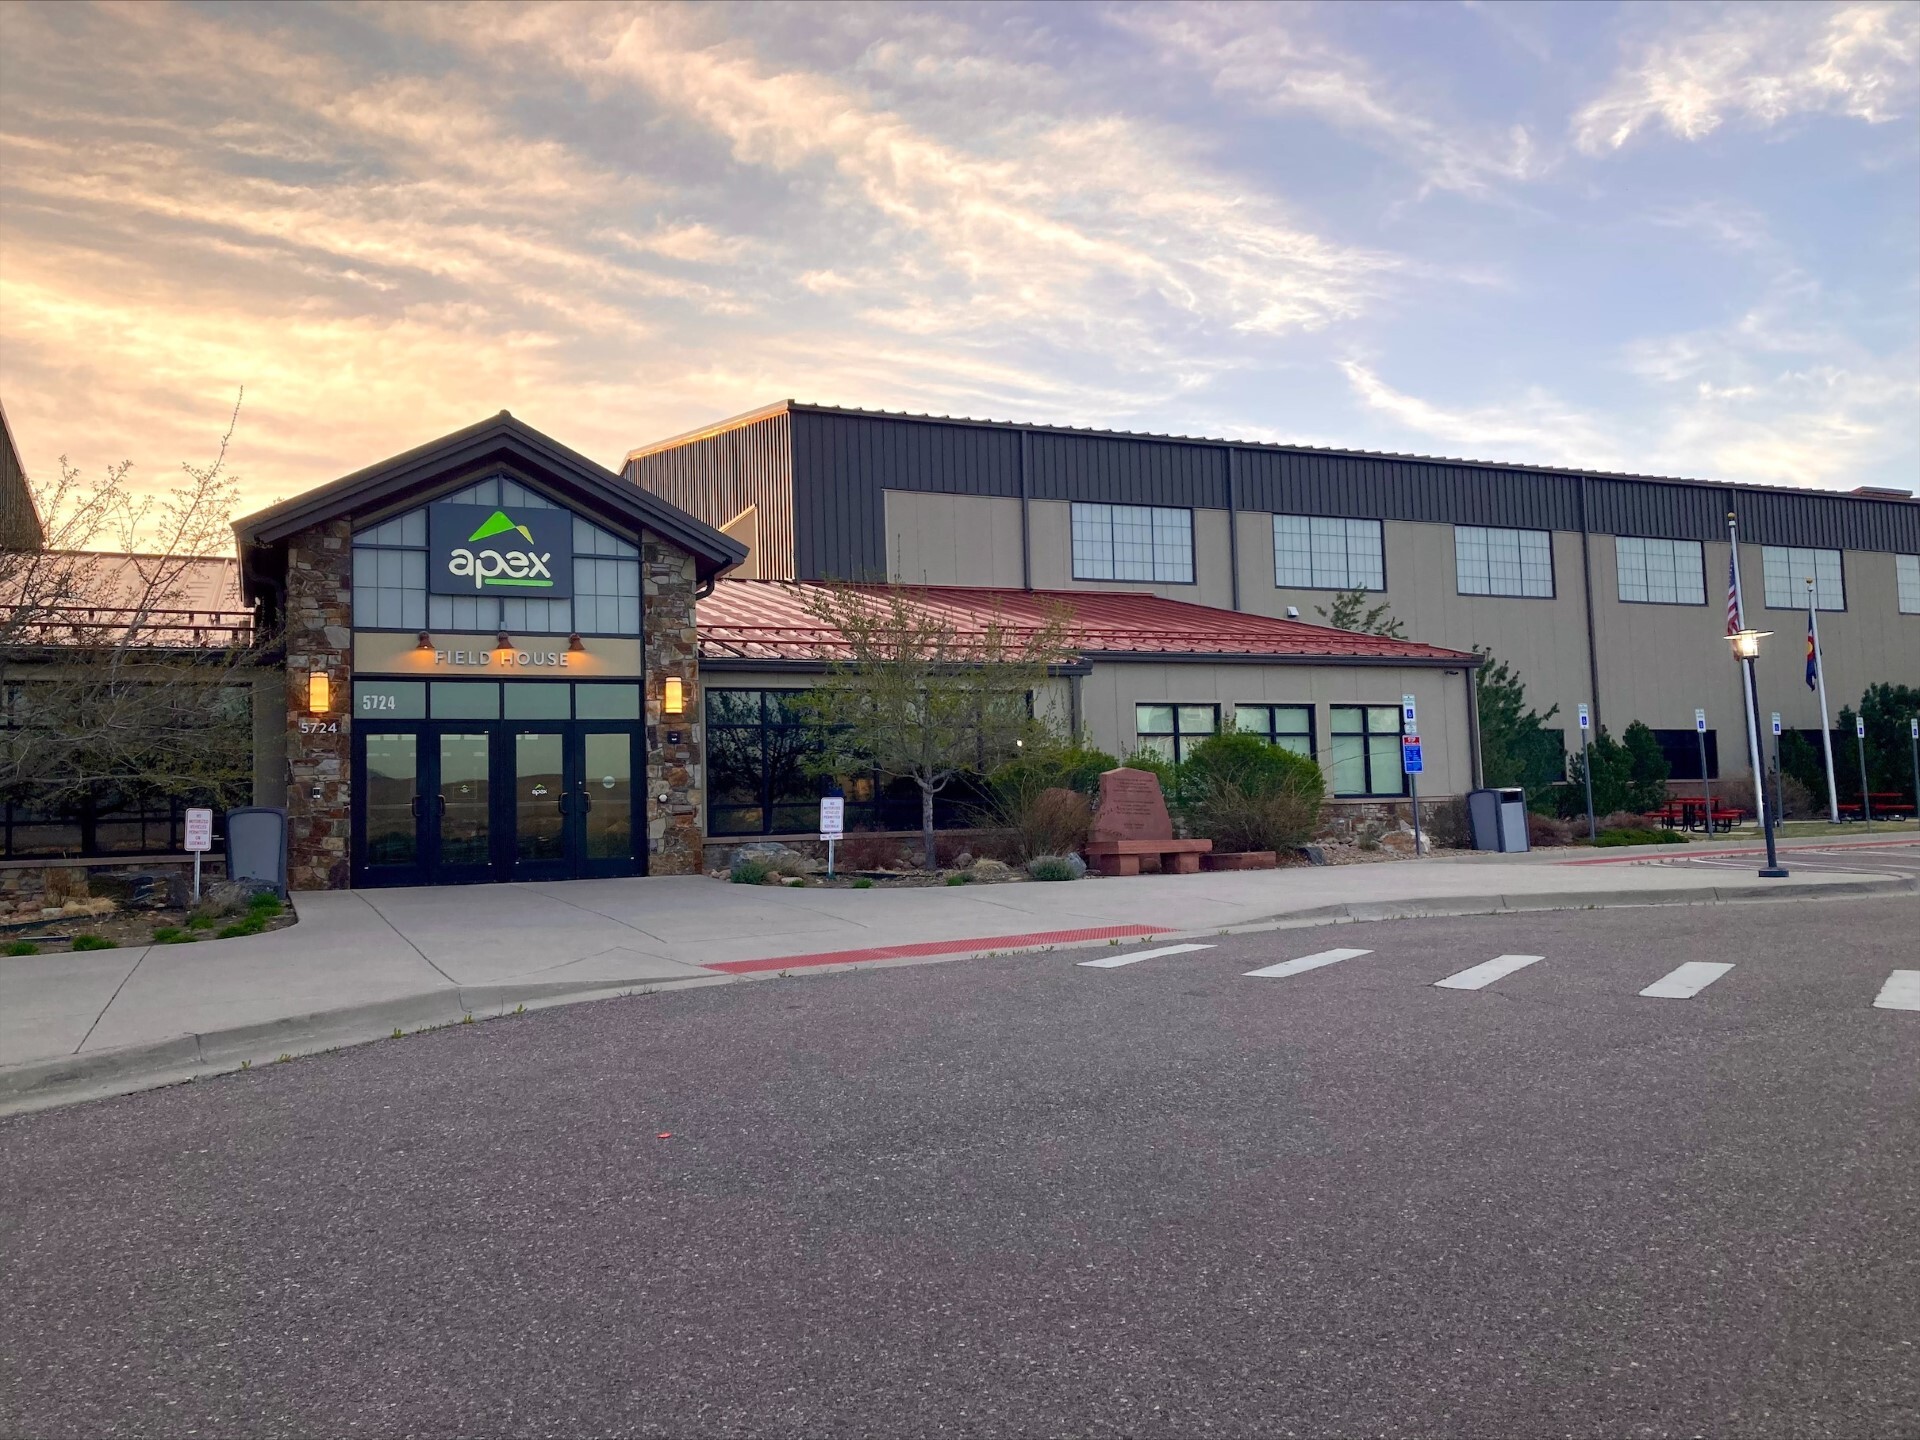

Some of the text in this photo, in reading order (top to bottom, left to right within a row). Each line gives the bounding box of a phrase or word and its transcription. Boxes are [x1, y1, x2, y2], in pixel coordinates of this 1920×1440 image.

[448, 548, 551, 590] apex
[434, 650, 569, 667] FIELD HOUSE
[363, 695, 396, 710] 5724
[301, 722, 338, 734] 5724
